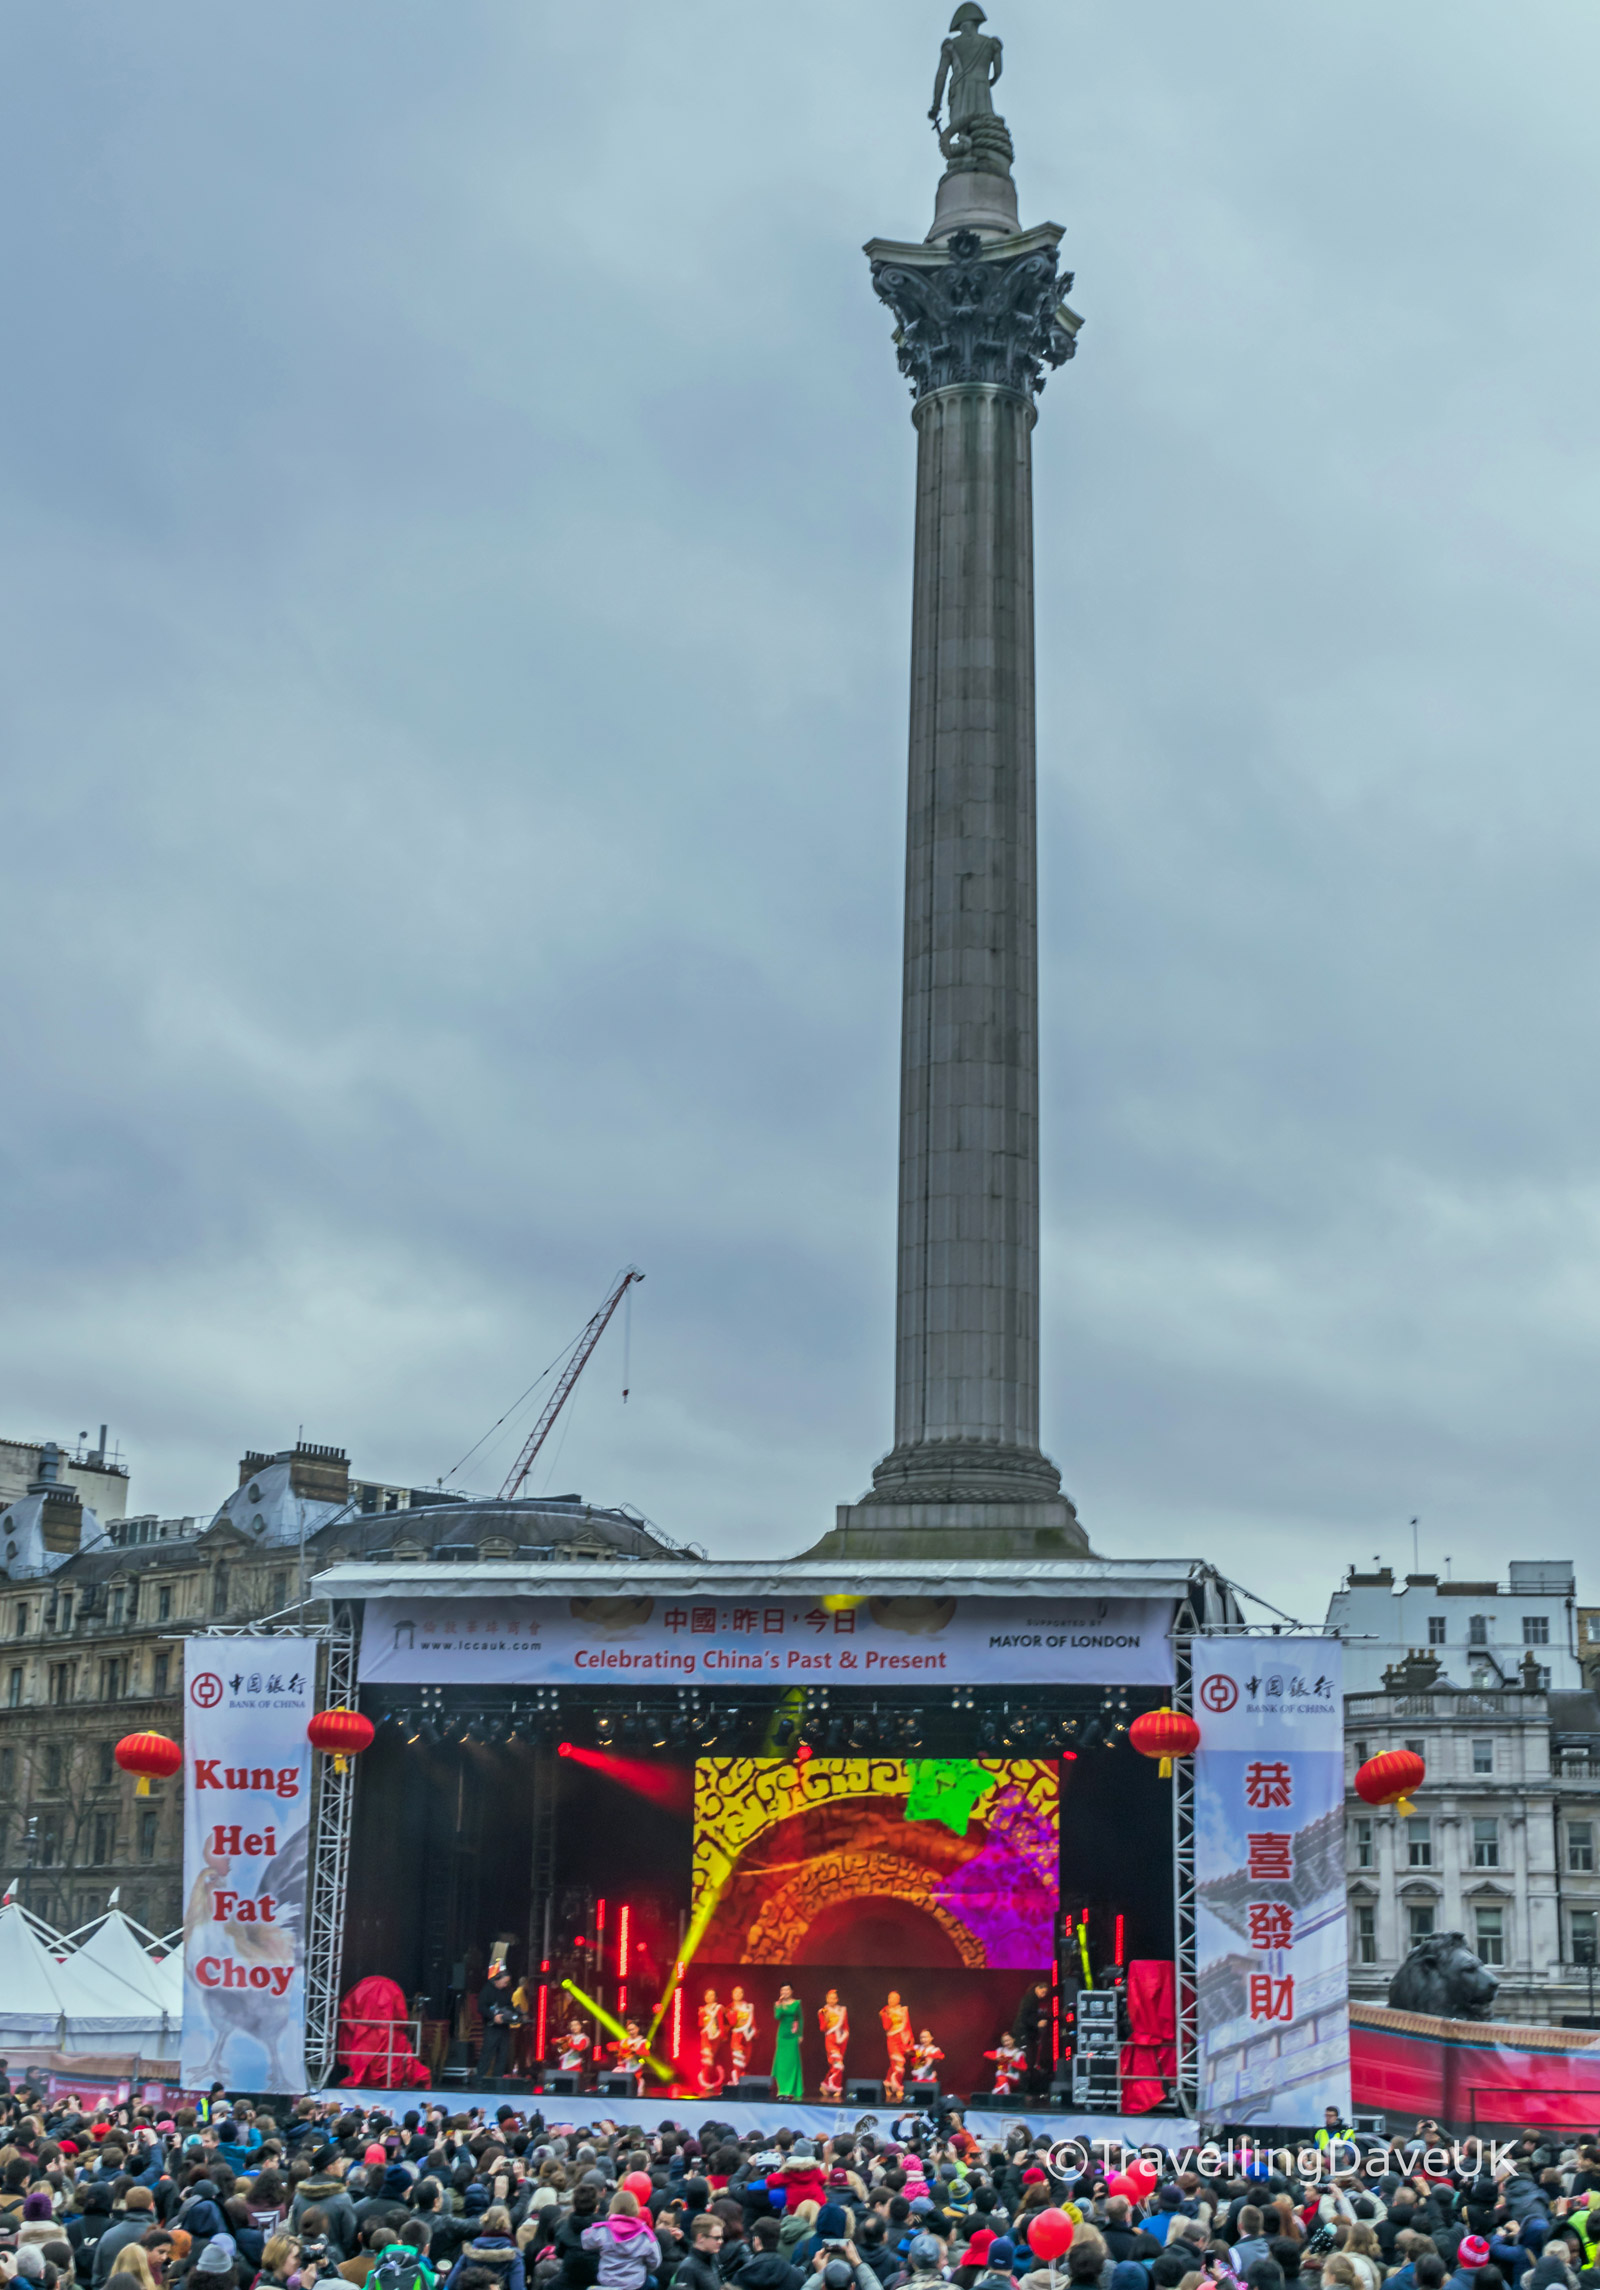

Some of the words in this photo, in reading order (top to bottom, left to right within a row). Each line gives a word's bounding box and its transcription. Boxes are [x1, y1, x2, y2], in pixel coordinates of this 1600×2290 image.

[1026, 1618, 1086, 1628] SUPPORTED
[421, 1640, 542, 1651] www.lccauk.com
[989, 1635, 1042, 1648] MAYOR
[1046, 1635, 1067, 1648] OF
[1071, 1635, 1140, 1648] LONDON
[574, 1649, 696, 1673] Celebrating
[703, 1649, 780, 1669] China’s
[787, 1650, 832, 1669] Past
[839, 1650, 858, 1669] &
[865, 1650, 947, 1669] Present
[229, 1700, 256, 1708] BANK
[258, 1700, 270, 1708] OF
[273, 1700, 306, 1708] CHINA
[1246, 1704, 1278, 1713] BANK
[1281, 1704, 1295, 1713] OF
[1297, 1704, 1336, 1714] CHINA
[194, 1759, 299, 1798] Kung
[212, 1825, 277, 1856] Hei
[212, 1891, 276, 1922] Fat
[195, 1956, 294, 1996] Choy
